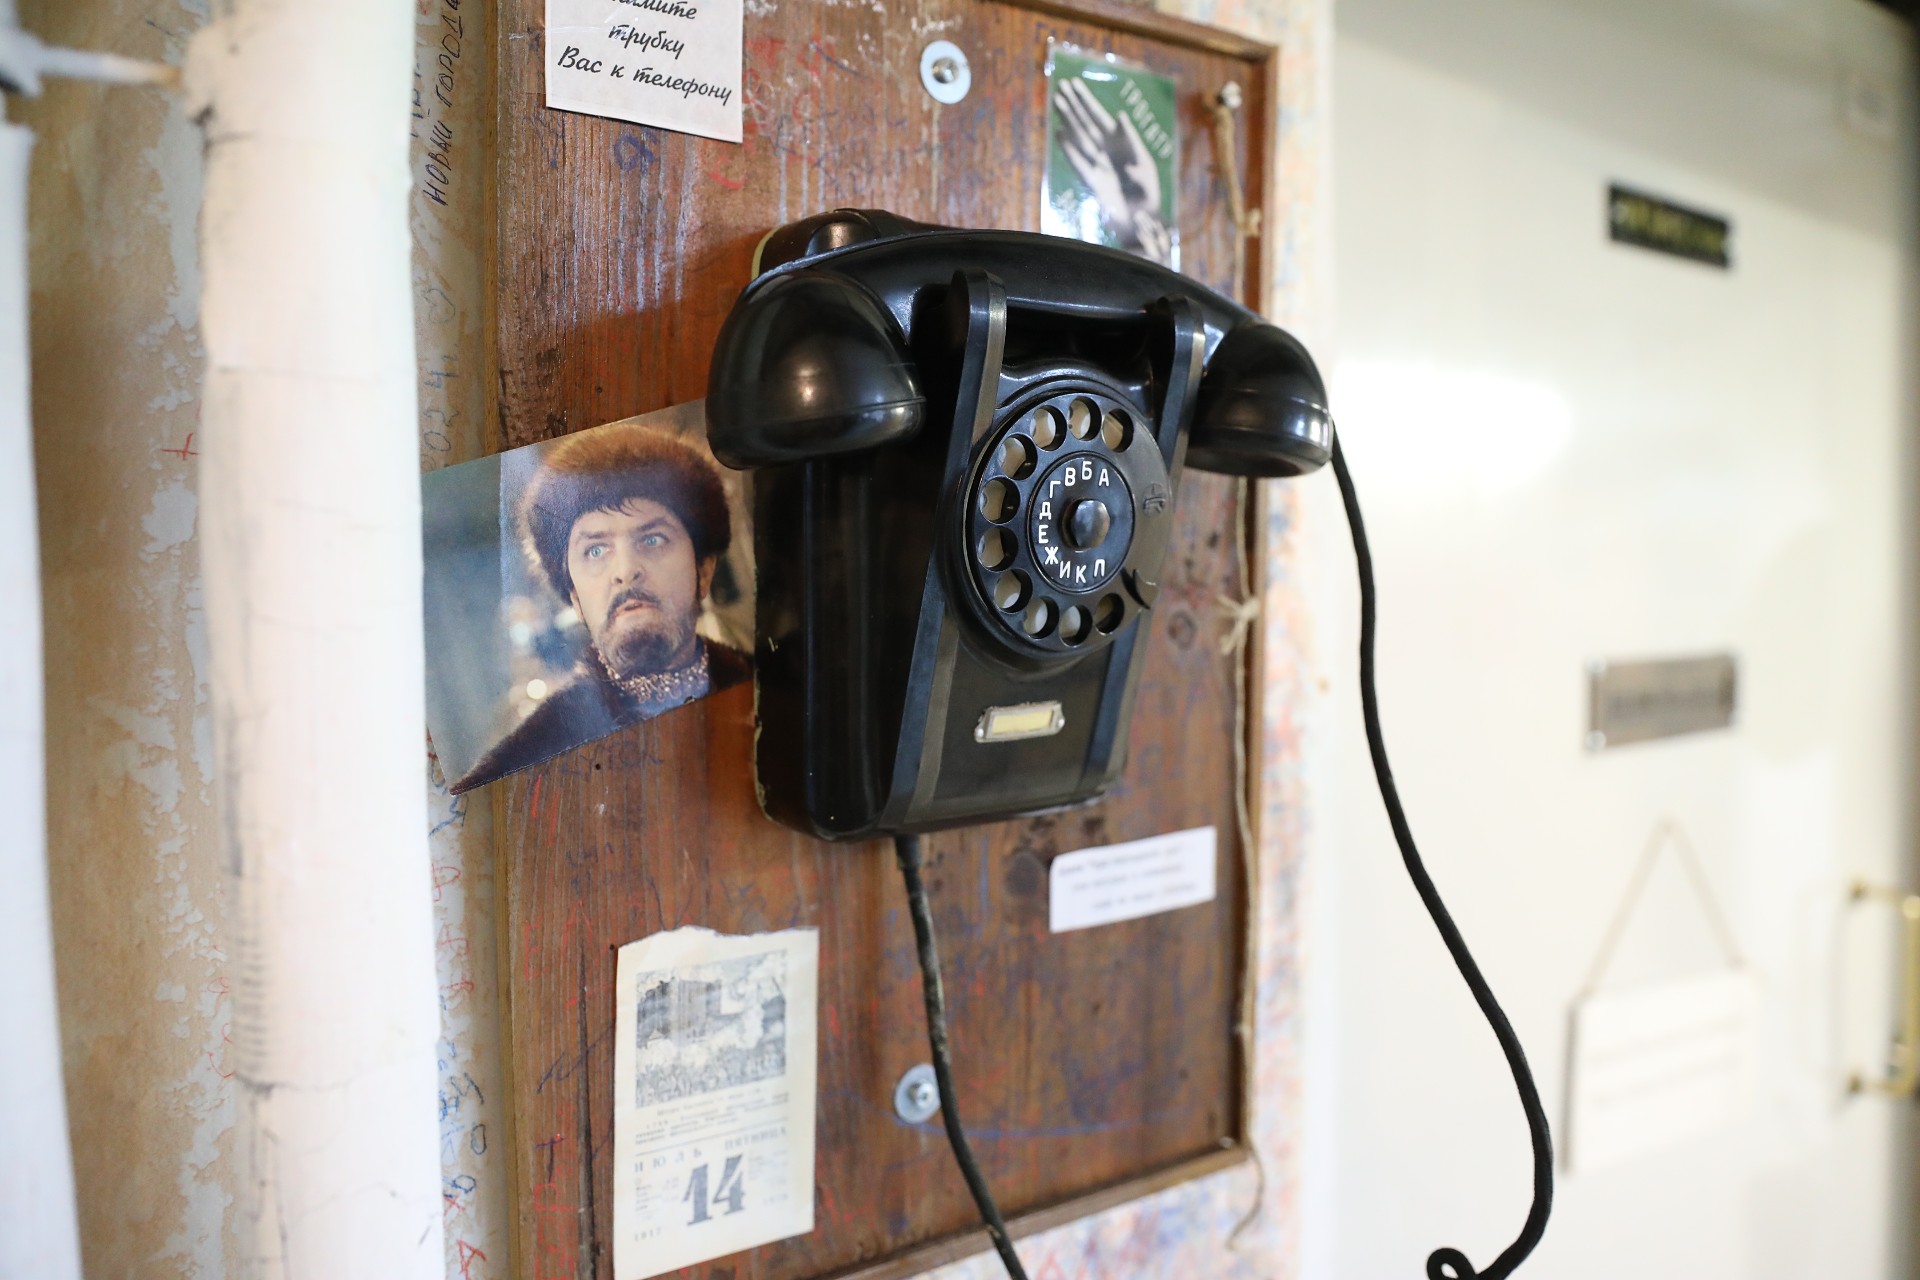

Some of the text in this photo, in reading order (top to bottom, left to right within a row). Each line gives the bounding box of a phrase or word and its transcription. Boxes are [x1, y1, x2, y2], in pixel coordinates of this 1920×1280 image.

[608, 24, 685, 60] трубку
[557, 45, 733, 106] Вас к телефону
[1064, 467, 1076, 487] В
[1081, 460, 1093, 480] Б
[1098, 468, 1110, 487] А
[1049, 480, 1061, 499] Г
[1039, 501, 1052, 521] Д
[1038, 524, 1049, 544] Е
[1044, 546, 1059, 565] Ж
[1059, 560, 1071, 579] И
[1075, 565, 1087, 584] К
[682, 1153, 746, 1227] 14
